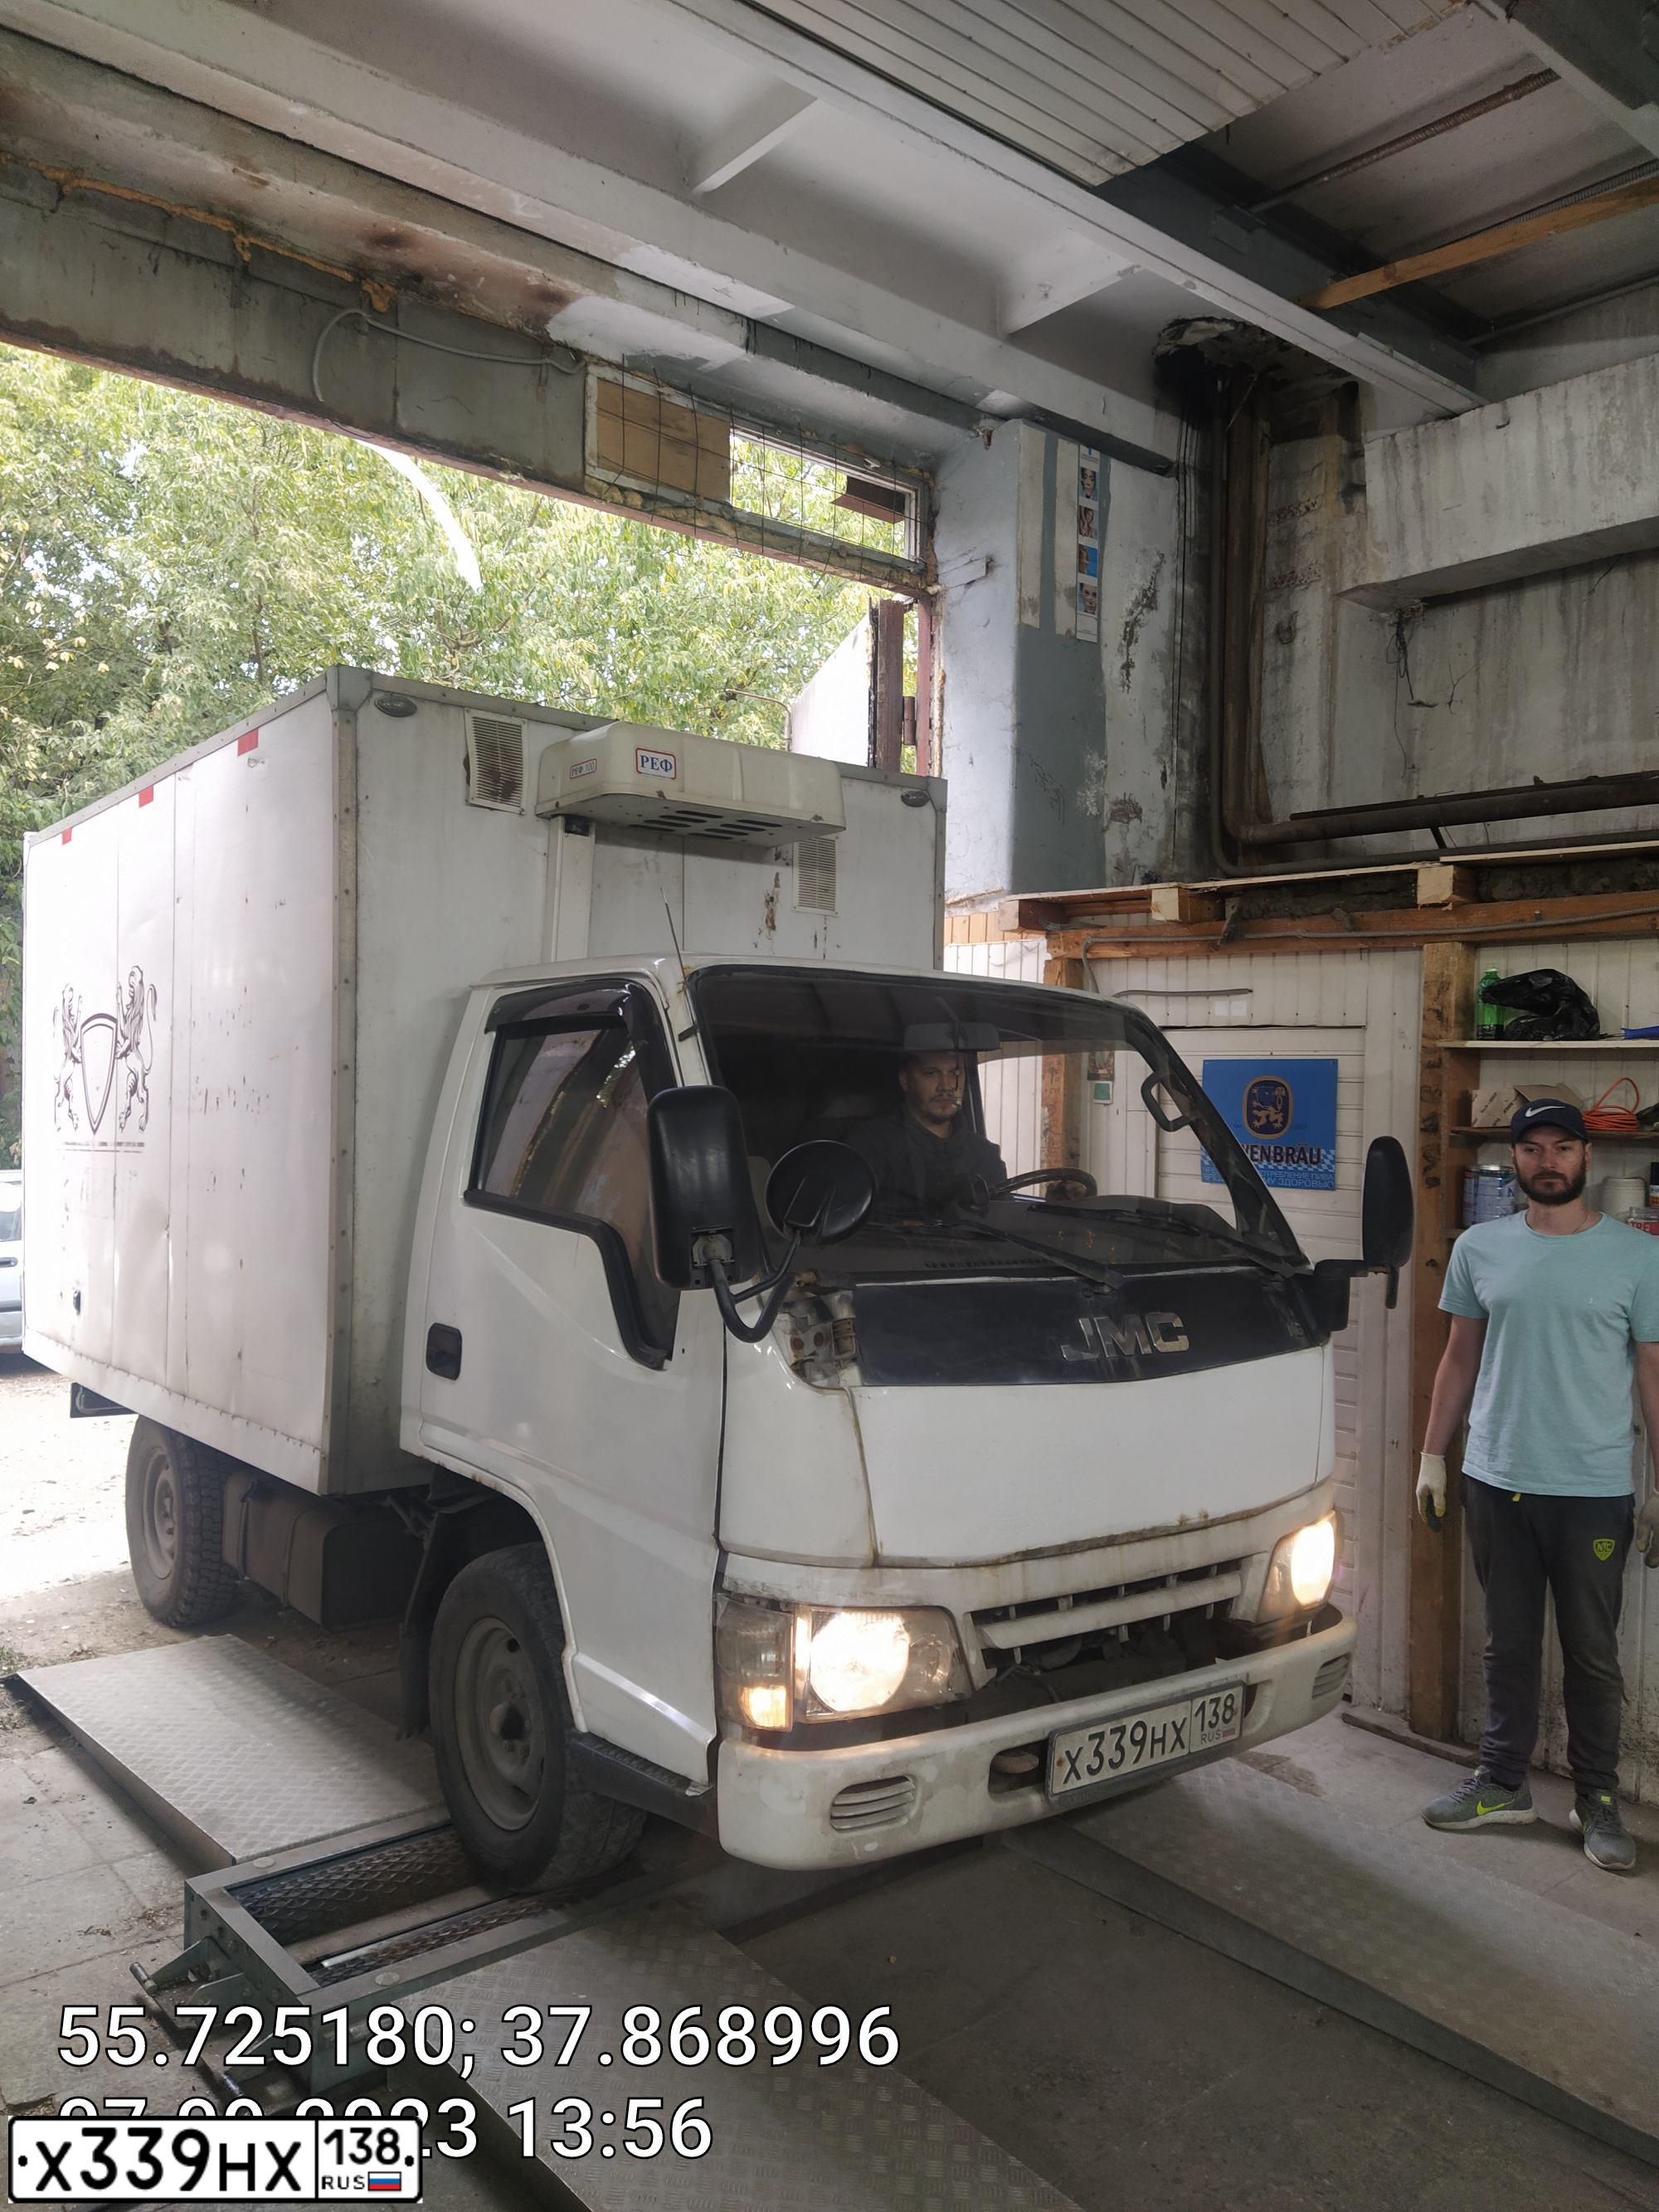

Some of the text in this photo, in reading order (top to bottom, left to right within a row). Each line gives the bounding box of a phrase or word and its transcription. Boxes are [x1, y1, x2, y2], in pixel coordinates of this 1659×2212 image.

[640, 754, 673, 772] РЕФ
[1243, 1142, 1321, 1165] ENBRÄU
[1261, 1170, 1310, 1179] ОТРЕБЛЕНИЕ
[1279, 1177, 1334, 1189] ЗДОРОВЬЮ
[1060, 1312, 1190, 1361] JMC
[1194, 1693, 1235, 1732] 138
[1200, 1729, 1221, 1745] RUS
